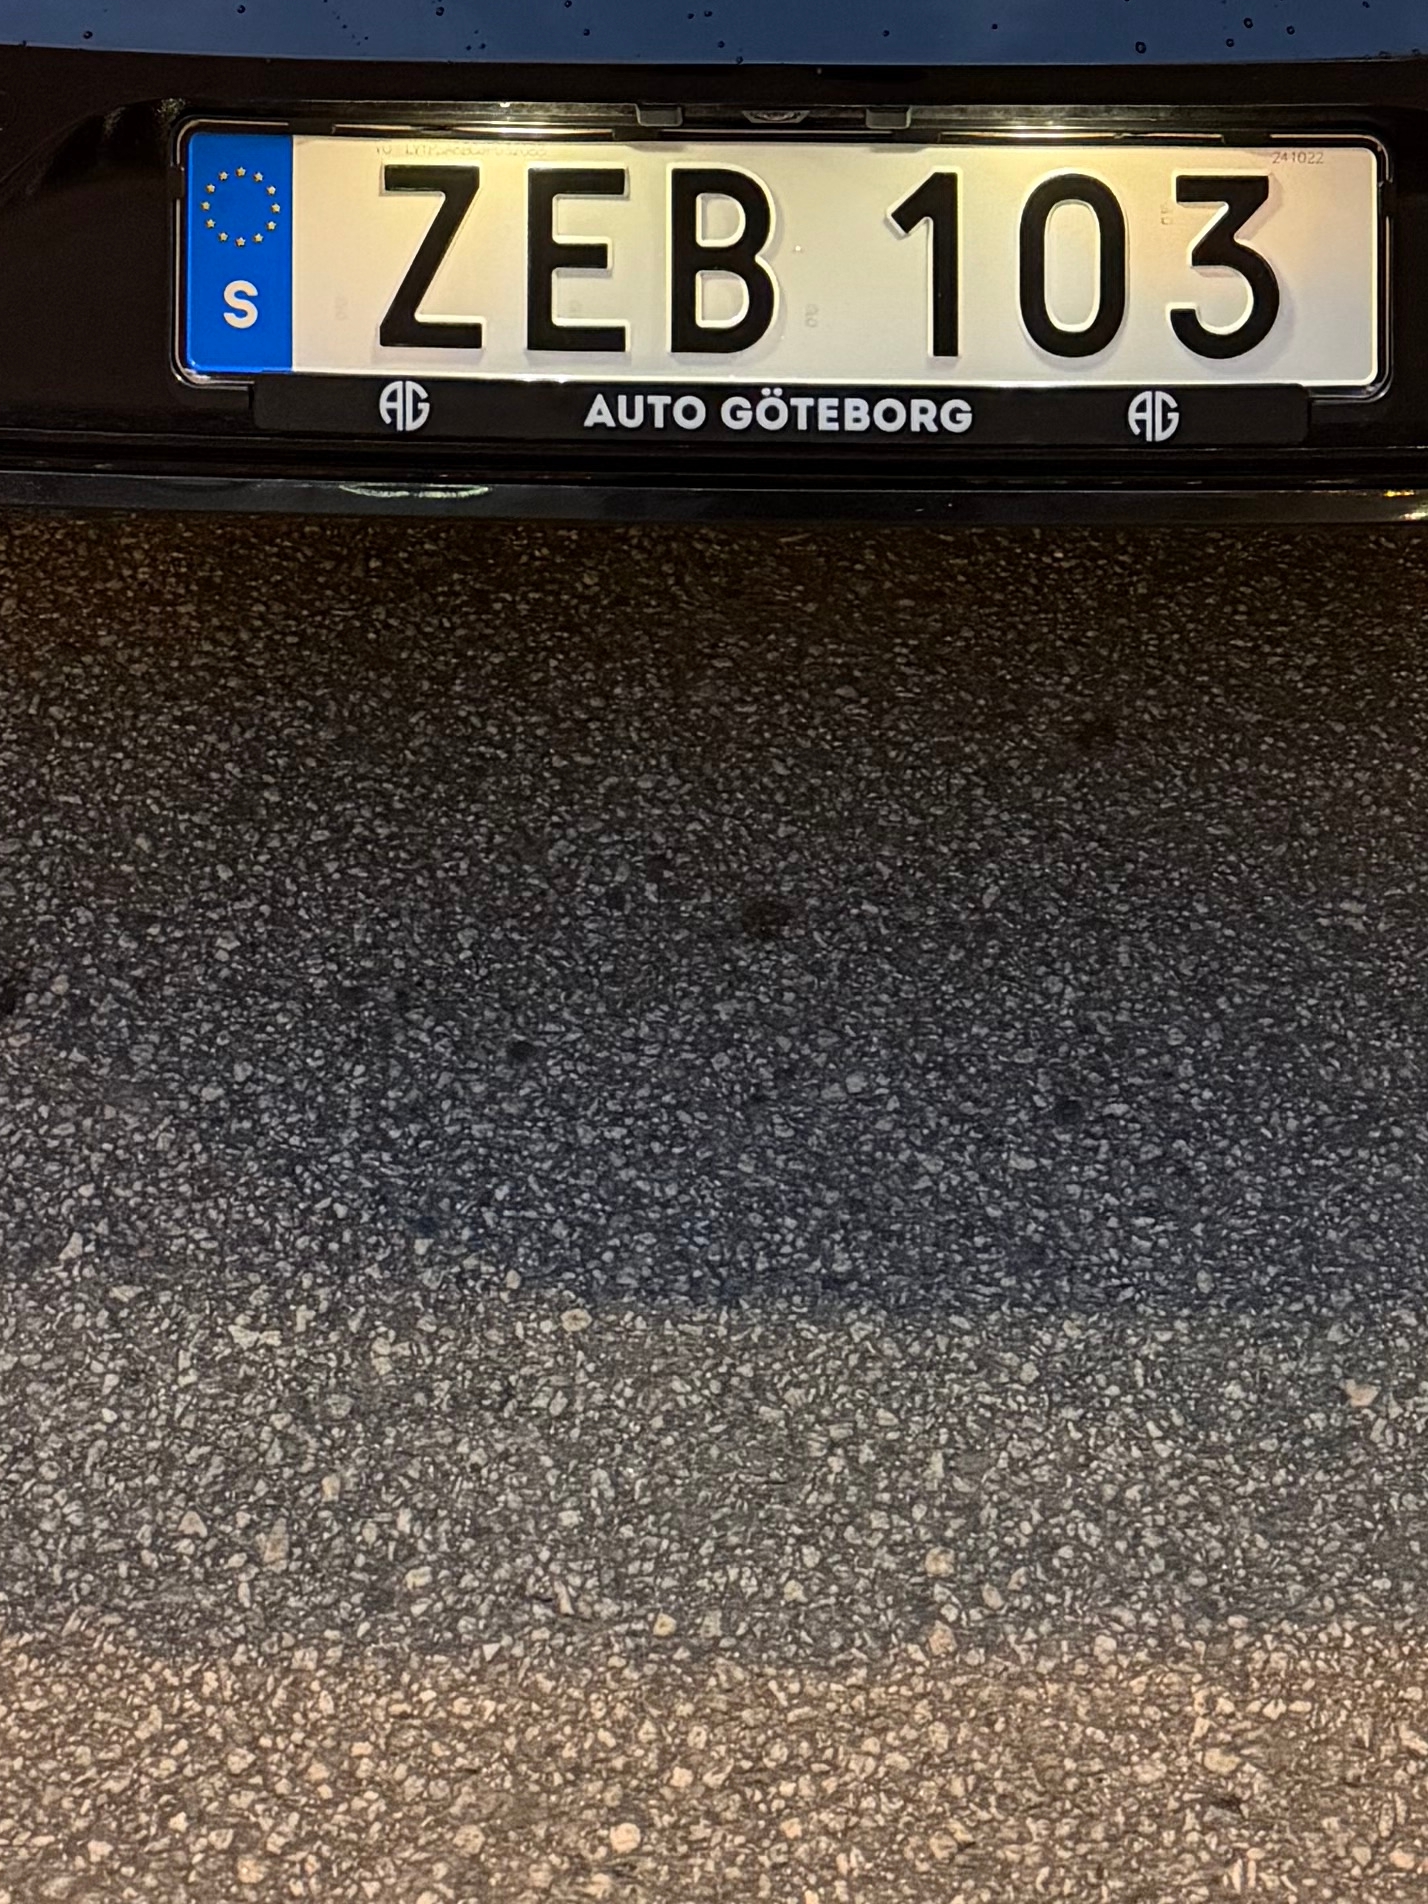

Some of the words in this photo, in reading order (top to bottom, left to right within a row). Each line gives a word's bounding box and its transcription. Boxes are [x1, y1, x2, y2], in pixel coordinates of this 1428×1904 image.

[1271, 151, 1325, 165] 241022
[379, 164, 775, 354] ZEB
[890, 171, 1281, 360] 103
[223, 279, 259, 330] S
[378, 380, 431, 432] AG
[583, 392, 707, 431] AUTO
[720, 386, 974, 435] GÖTEBORG
[1127, 389, 1181, 443] AG
